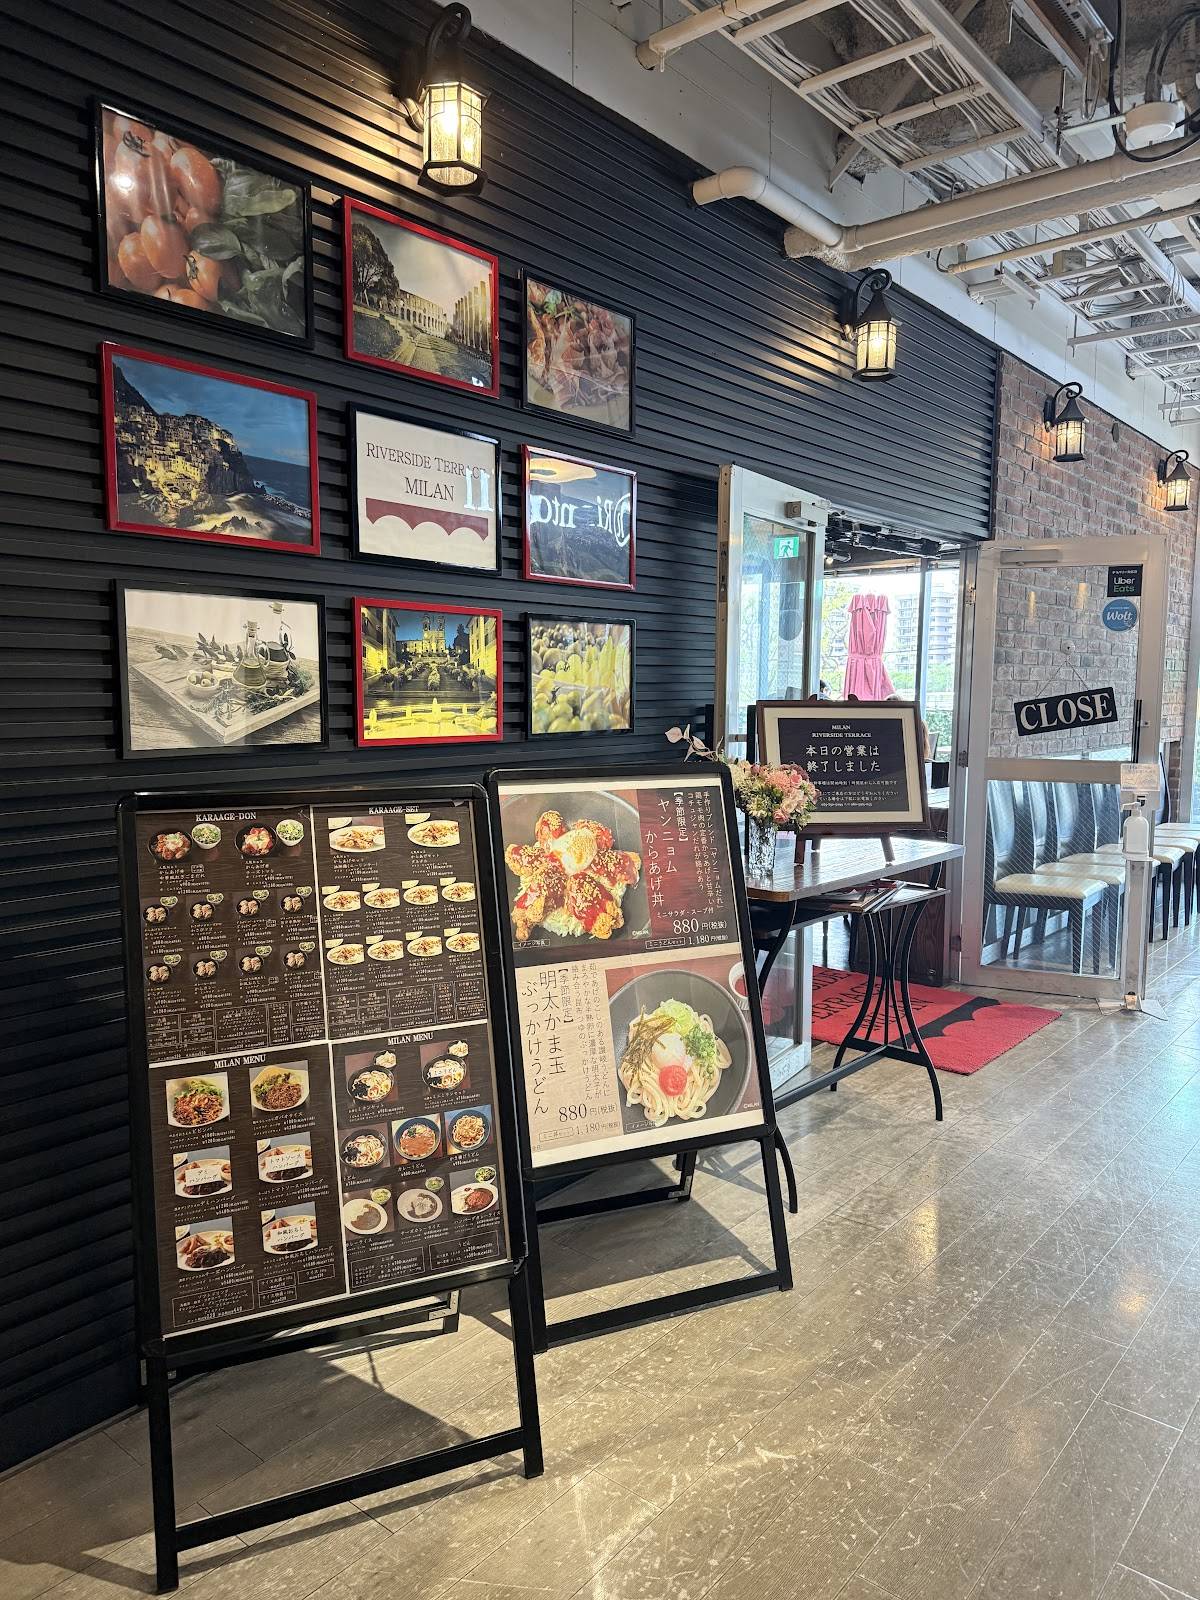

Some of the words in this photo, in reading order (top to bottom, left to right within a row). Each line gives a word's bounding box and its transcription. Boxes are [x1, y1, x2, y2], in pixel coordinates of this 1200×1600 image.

[367, 442, 431, 469] RIVERSIDE
[405, 477, 455, 502] MILAN
[1113, 576, 1135, 585] Uber
[1113, 585, 1135, 593] Eats
[1107, 611, 1133, 621] Wolt
[1020, 692, 1113, 731] CLOSE
[805, 744, 880, 756] 本日の営業は
[806, 760, 881, 772] 終了しました
[195, 811, 257, 822] KARAAGE-DON
[368, 805, 420, 815] KARAAGE-SET
[673, 792, 689, 842] 【季節限定】
[657, 799, 678, 873] ヤンニョム
[645, 830, 665, 908] からあげ丼
[673, 918, 699, 935] 880
[558, 968, 574, 1024] 【季節限定】
[539, 971, 567, 1076] 明太かま玉
[387, 1036, 412, 1046] MILAN
[413, 1032, 434, 1042] MENU
[521, 981, 549, 1115] ぶっかけうどん
[214, 1058, 241, 1069] MILAN
[242, 1053, 267, 1065] MENU
[558, 1103, 588, 1123] 880
